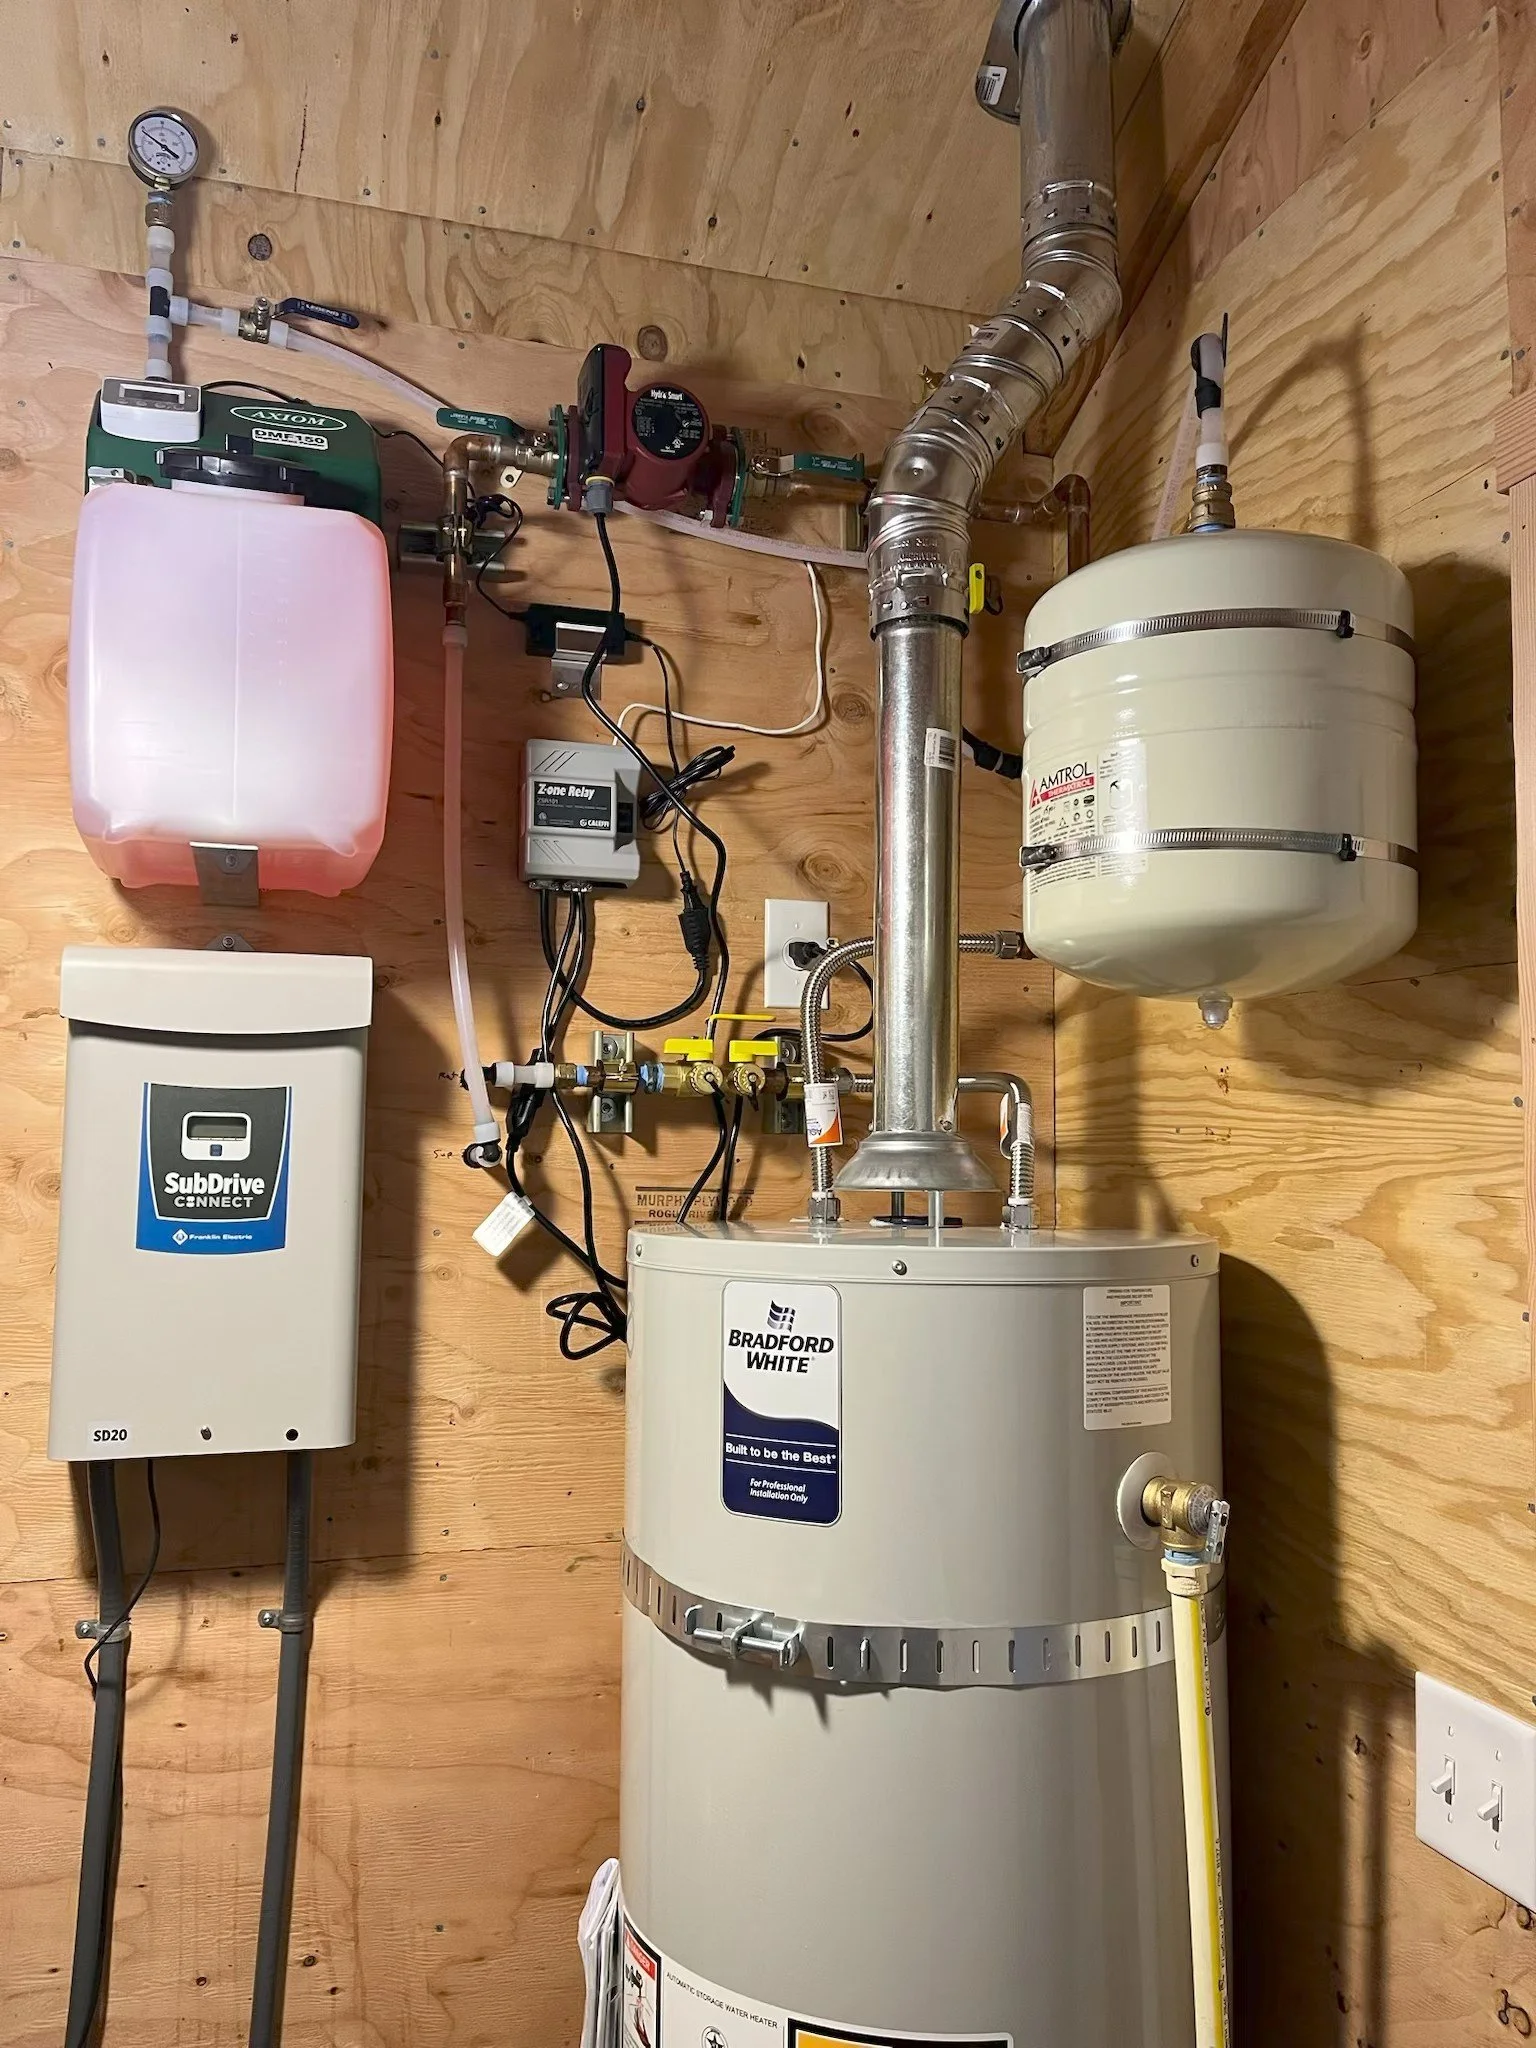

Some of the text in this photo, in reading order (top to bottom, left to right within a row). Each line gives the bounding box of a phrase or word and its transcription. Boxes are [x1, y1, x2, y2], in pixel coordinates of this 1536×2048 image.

[251, 411, 325, 426] AXIOM
[255, 430, 325, 444] DMF150
[1040, 762, 1094, 792] AMTROL
[567, 785, 596, 801] Relay
[164, 1171, 266, 1195] SubDrive
[173, 1195, 254, 1209] CONNECT
[189, 1232, 253, 1241] Franklin Electric
[728, 1329, 835, 1354] BRADFORD
[746, 1351, 810, 1374] WHITE
[93, 1428, 128, 1442] SD20
[725, 1442, 748, 1456] Built
[749, 1446, 761, 1458] to
[763, 1447, 778, 1460] be
[781, 1449, 800, 1462] the
[749, 1478, 806, 1493] For Professional
[749, 1488, 808, 1505] Installation Only
[666, 1971, 778, 2029] AUTOMATIC STORAGE WATER HEATER
